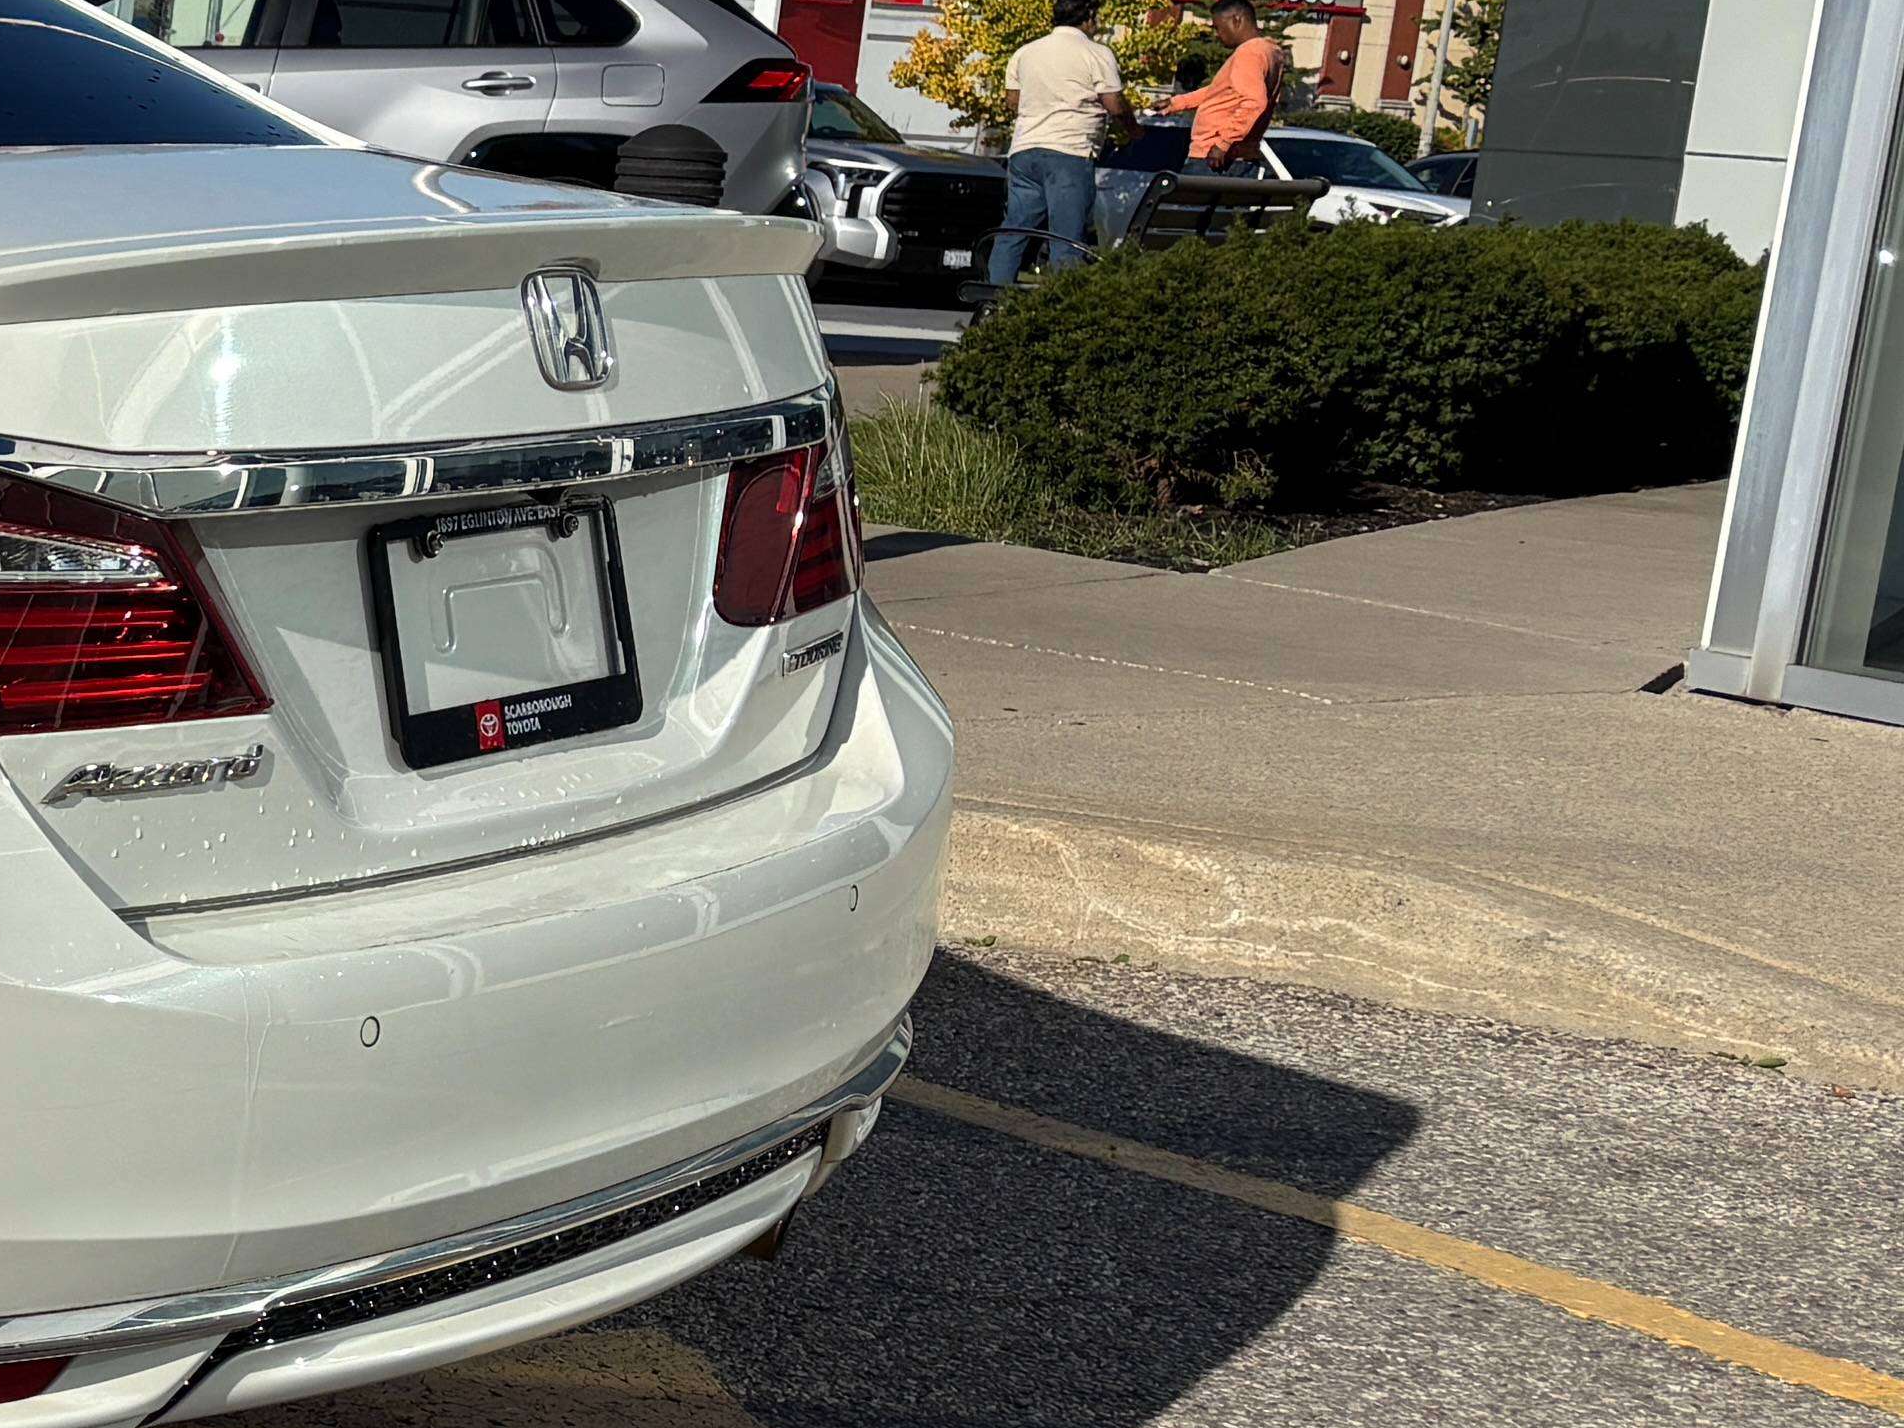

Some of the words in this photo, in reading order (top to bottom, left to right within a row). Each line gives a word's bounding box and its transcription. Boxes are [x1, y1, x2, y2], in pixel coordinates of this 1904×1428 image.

[504, 694, 572, 720] SCARBOROUGH
[506, 716, 541, 735] TOYOTA
[41, 744, 264, 804] Accord
